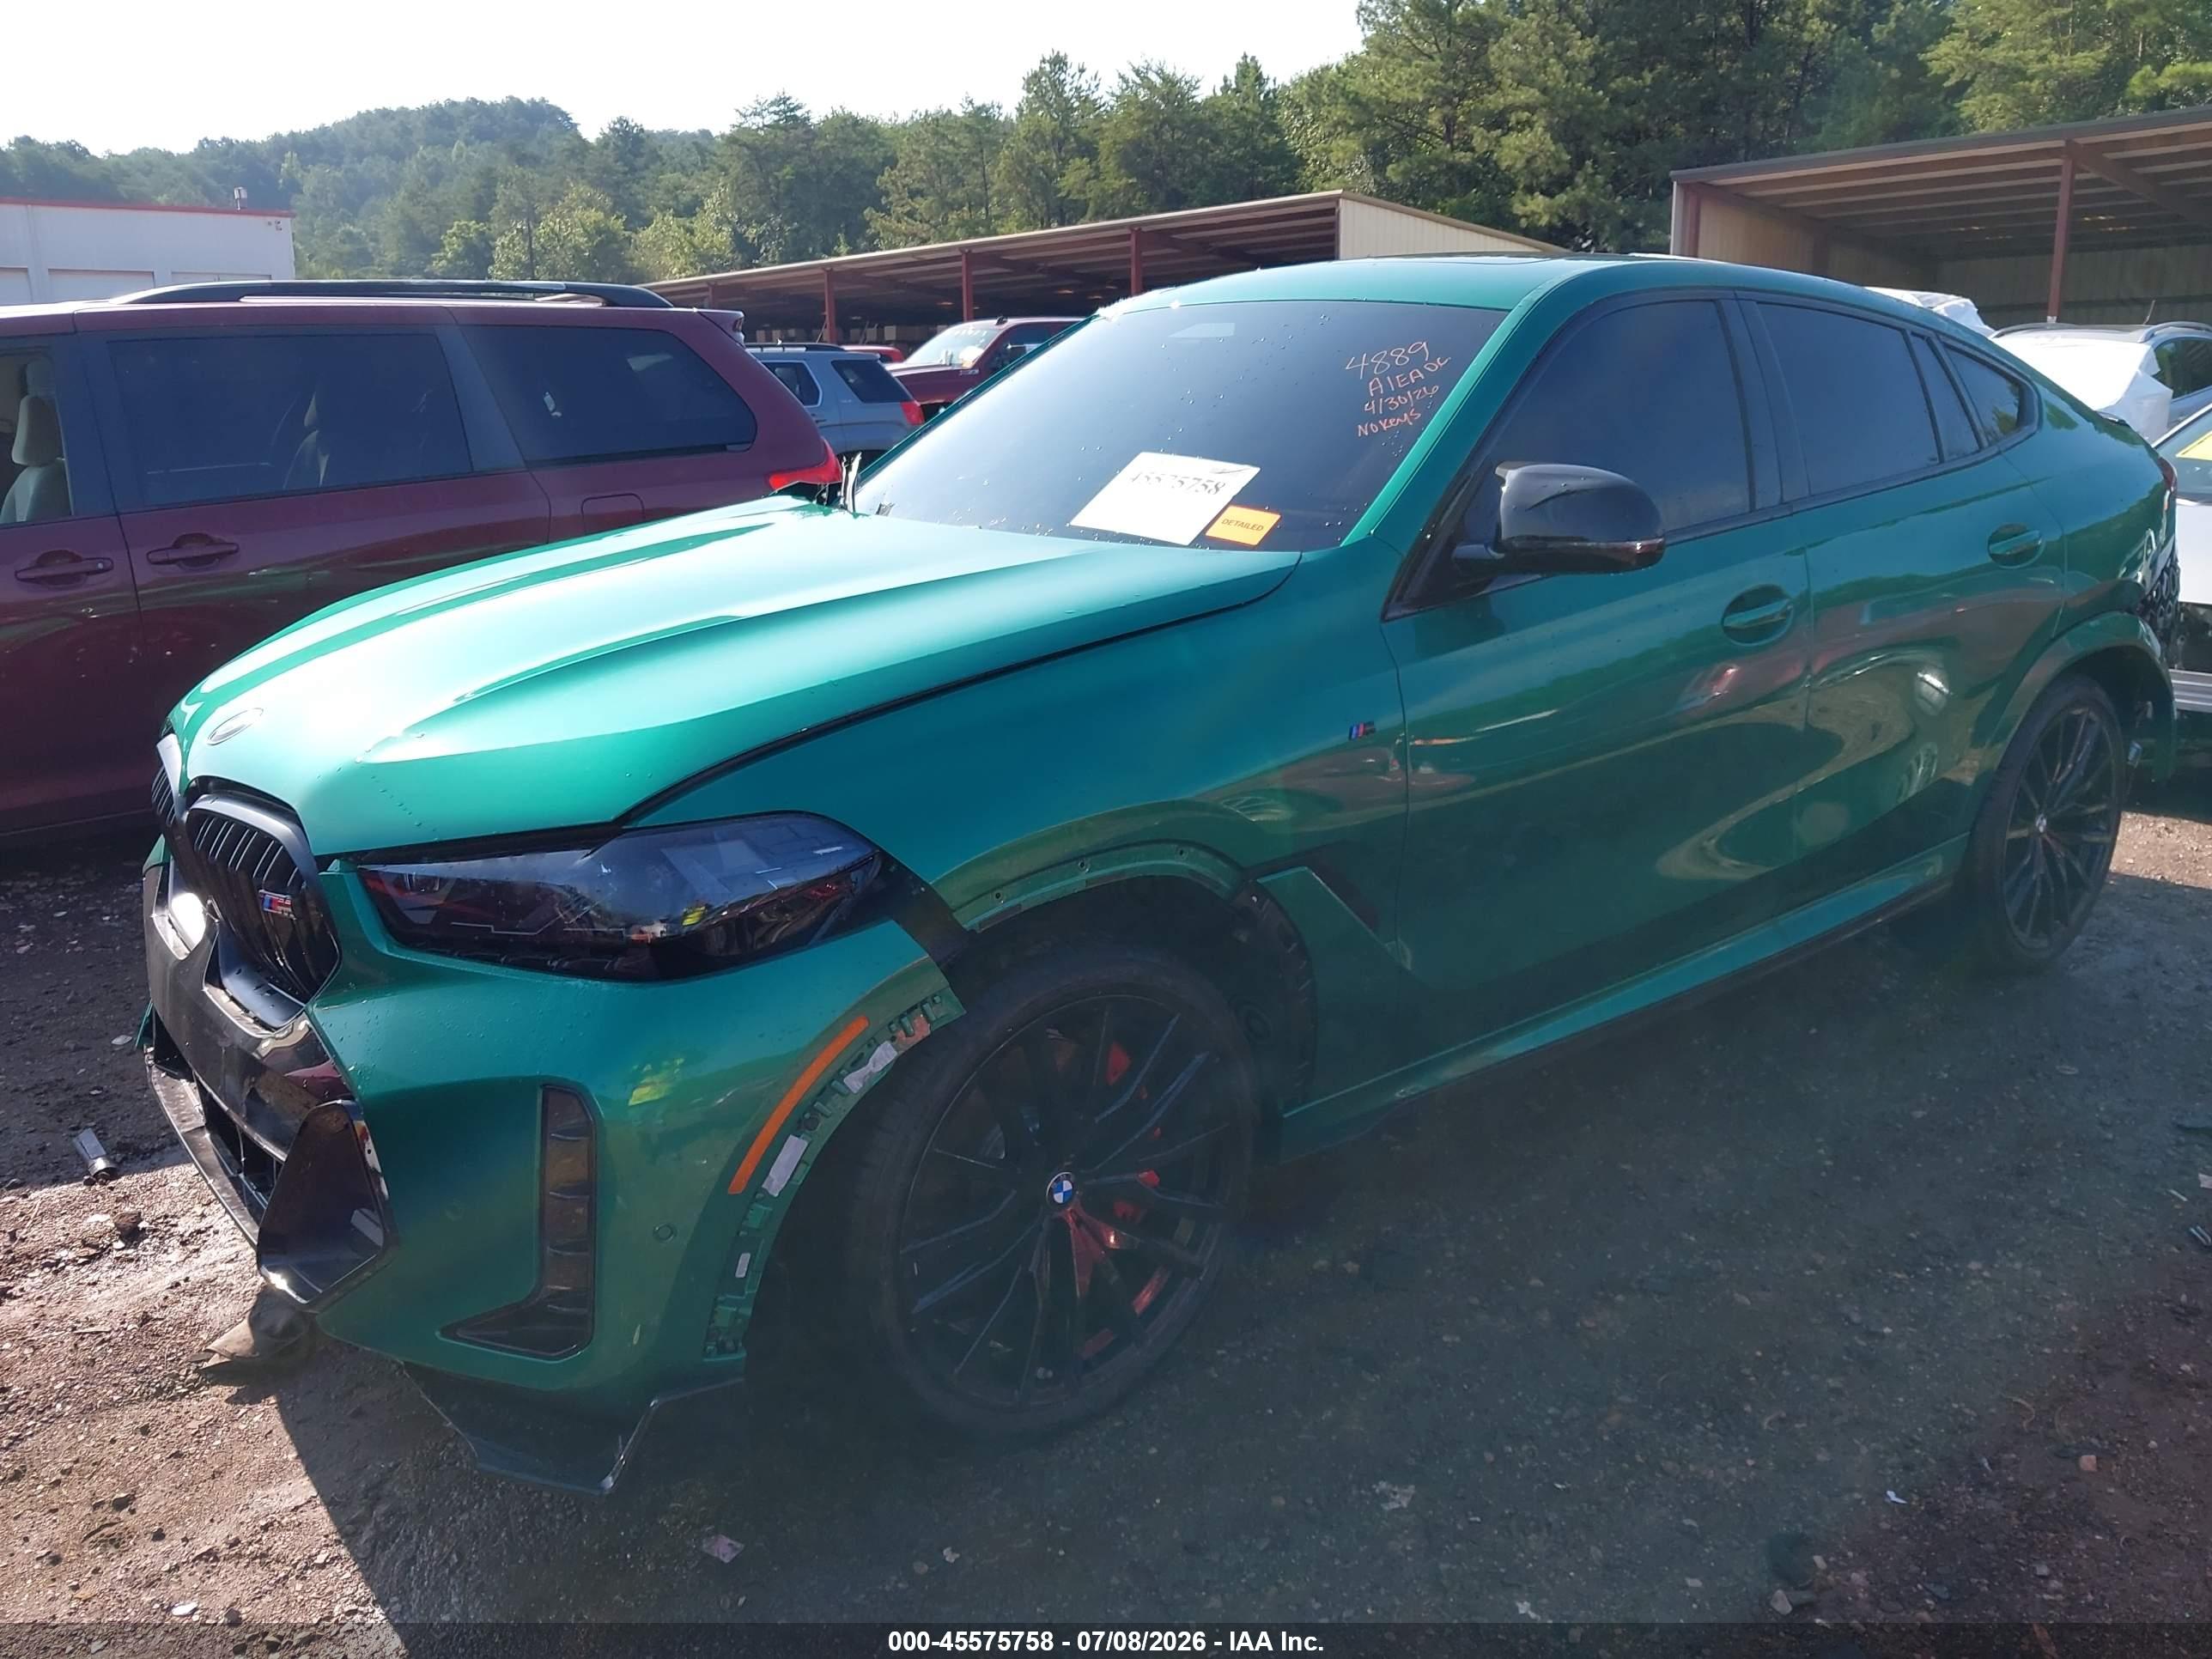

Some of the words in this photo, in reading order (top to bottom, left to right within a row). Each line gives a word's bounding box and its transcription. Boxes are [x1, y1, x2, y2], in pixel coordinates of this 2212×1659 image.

[1346, 341, 1429, 380] 4889
[1364, 386, 1438, 414] 4/30/26
[1221, 518, 1264, 532] DETAILED
